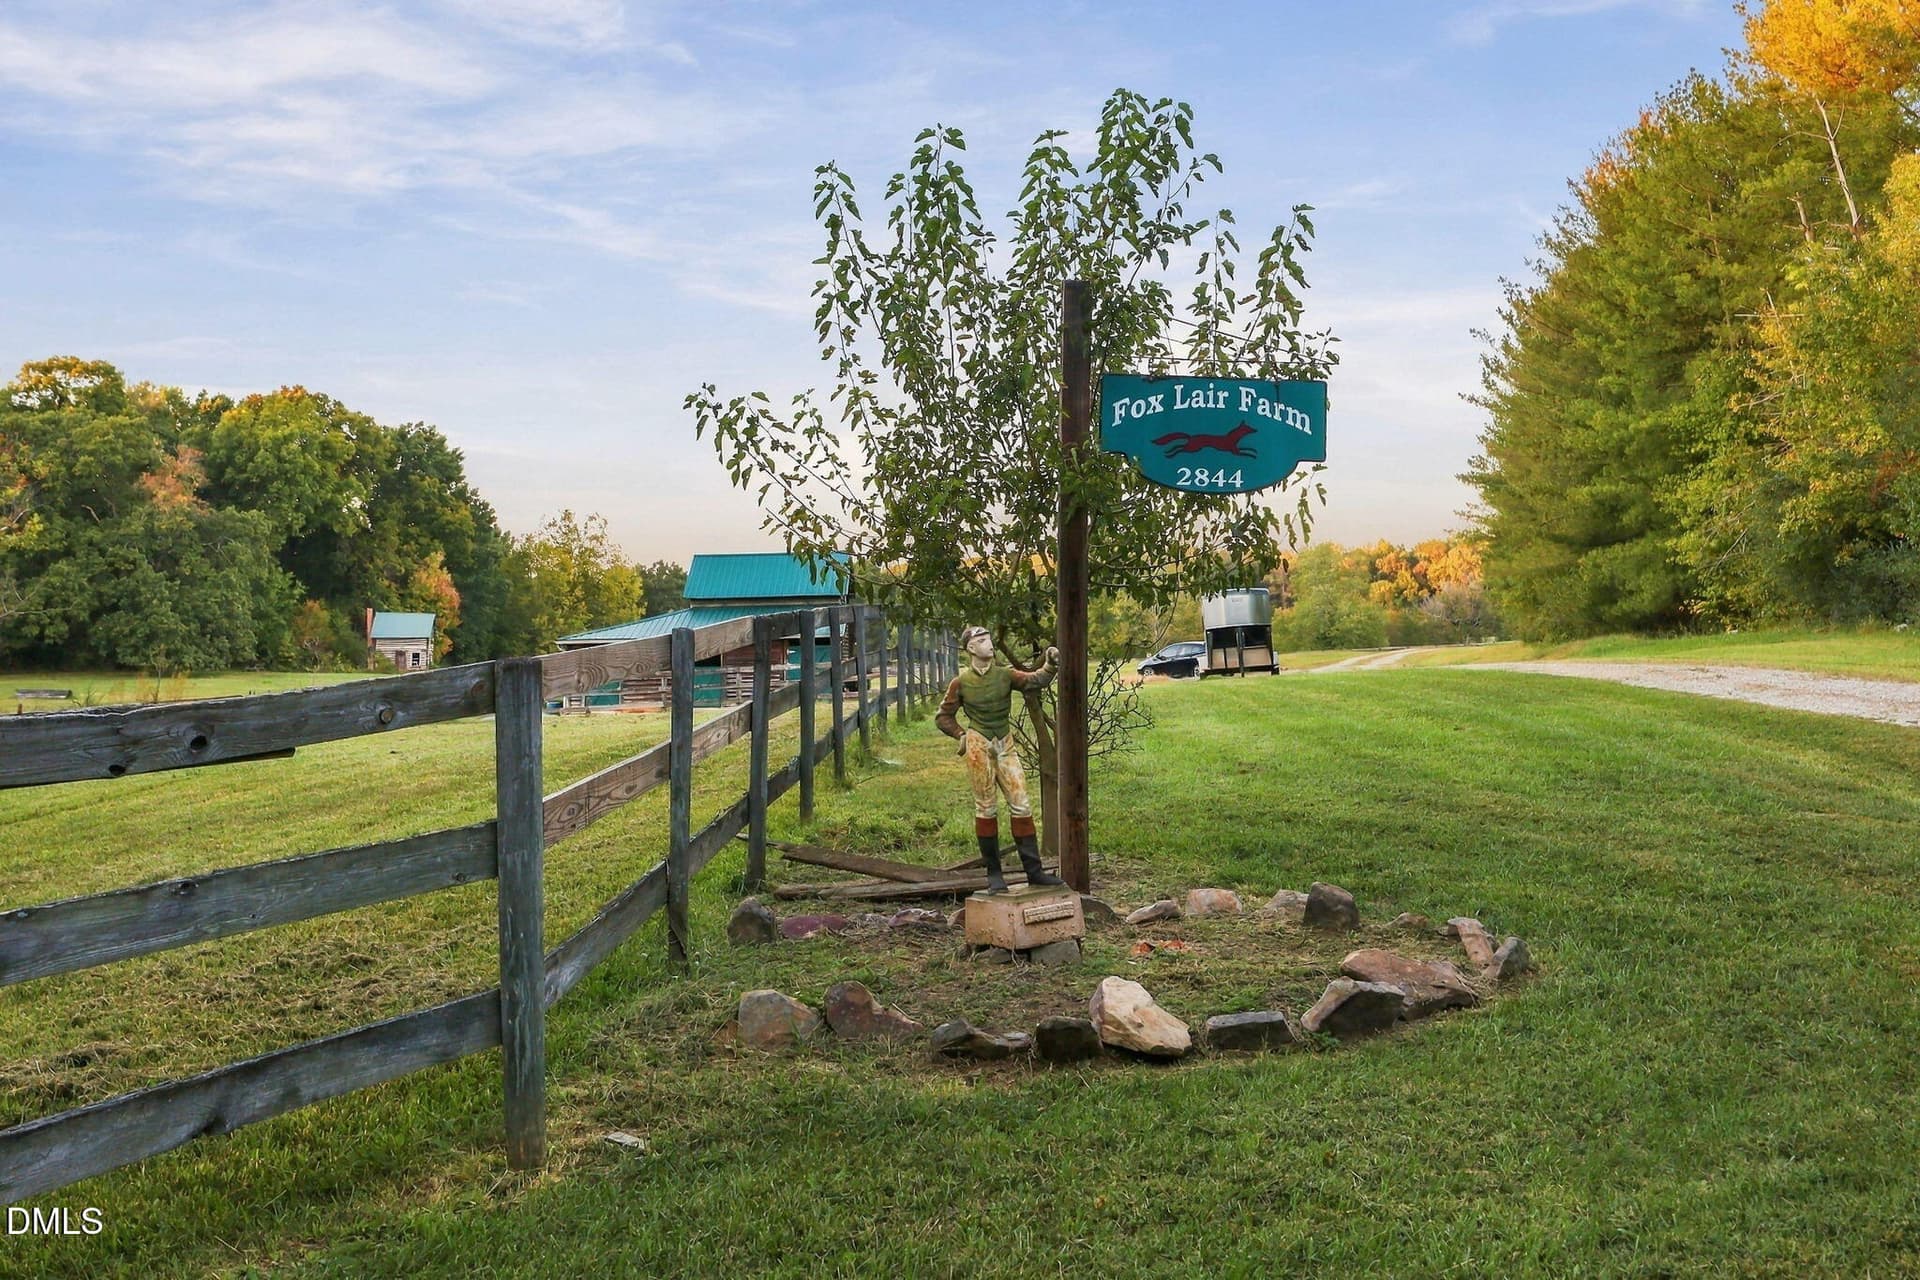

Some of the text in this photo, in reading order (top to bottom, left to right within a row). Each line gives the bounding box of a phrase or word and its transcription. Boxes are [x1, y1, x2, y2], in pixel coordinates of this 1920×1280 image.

[1111, 382, 1312, 435] Fox Lair Farm
[1176, 467, 1244, 488] 2844
